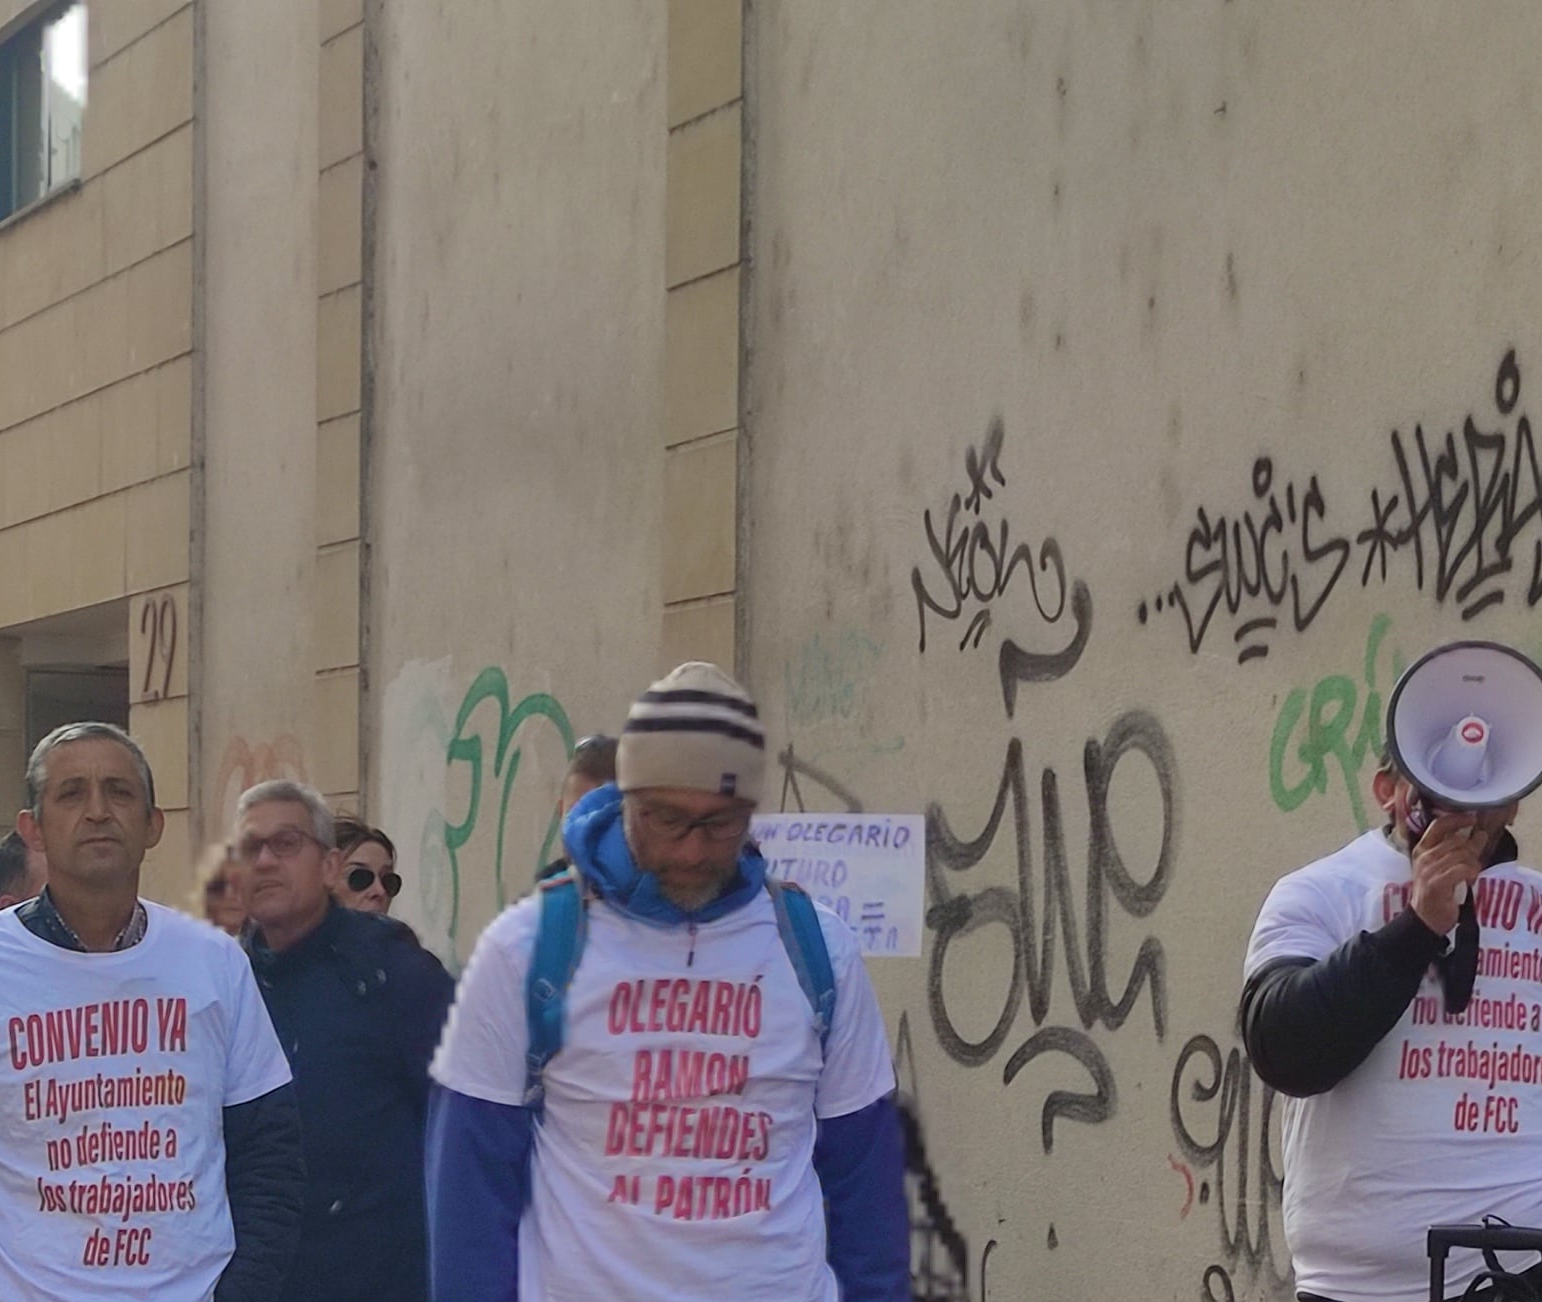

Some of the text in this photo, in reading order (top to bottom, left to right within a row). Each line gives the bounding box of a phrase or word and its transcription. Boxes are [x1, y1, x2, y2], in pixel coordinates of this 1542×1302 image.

[9, 998, 186, 1070] CONVENIO YA
[1412, 989, 1541, 1032] no fiende a
[631, 1049, 750, 1101] RAMON
[1399, 1040, 1432, 1080] los
[24, 1067, 186, 1124] El Ayuntamiento
[1454, 1092, 1519, 1133] de FCC
[47, 1121, 177, 1171] no defiende a
[604, 1103, 774, 1161] DEFIENDES
[37, 1174, 196, 1222] los trabajadores
[654, 1168, 772, 1221] PATRÓN
[82, 1227, 152, 1266] de FCC
